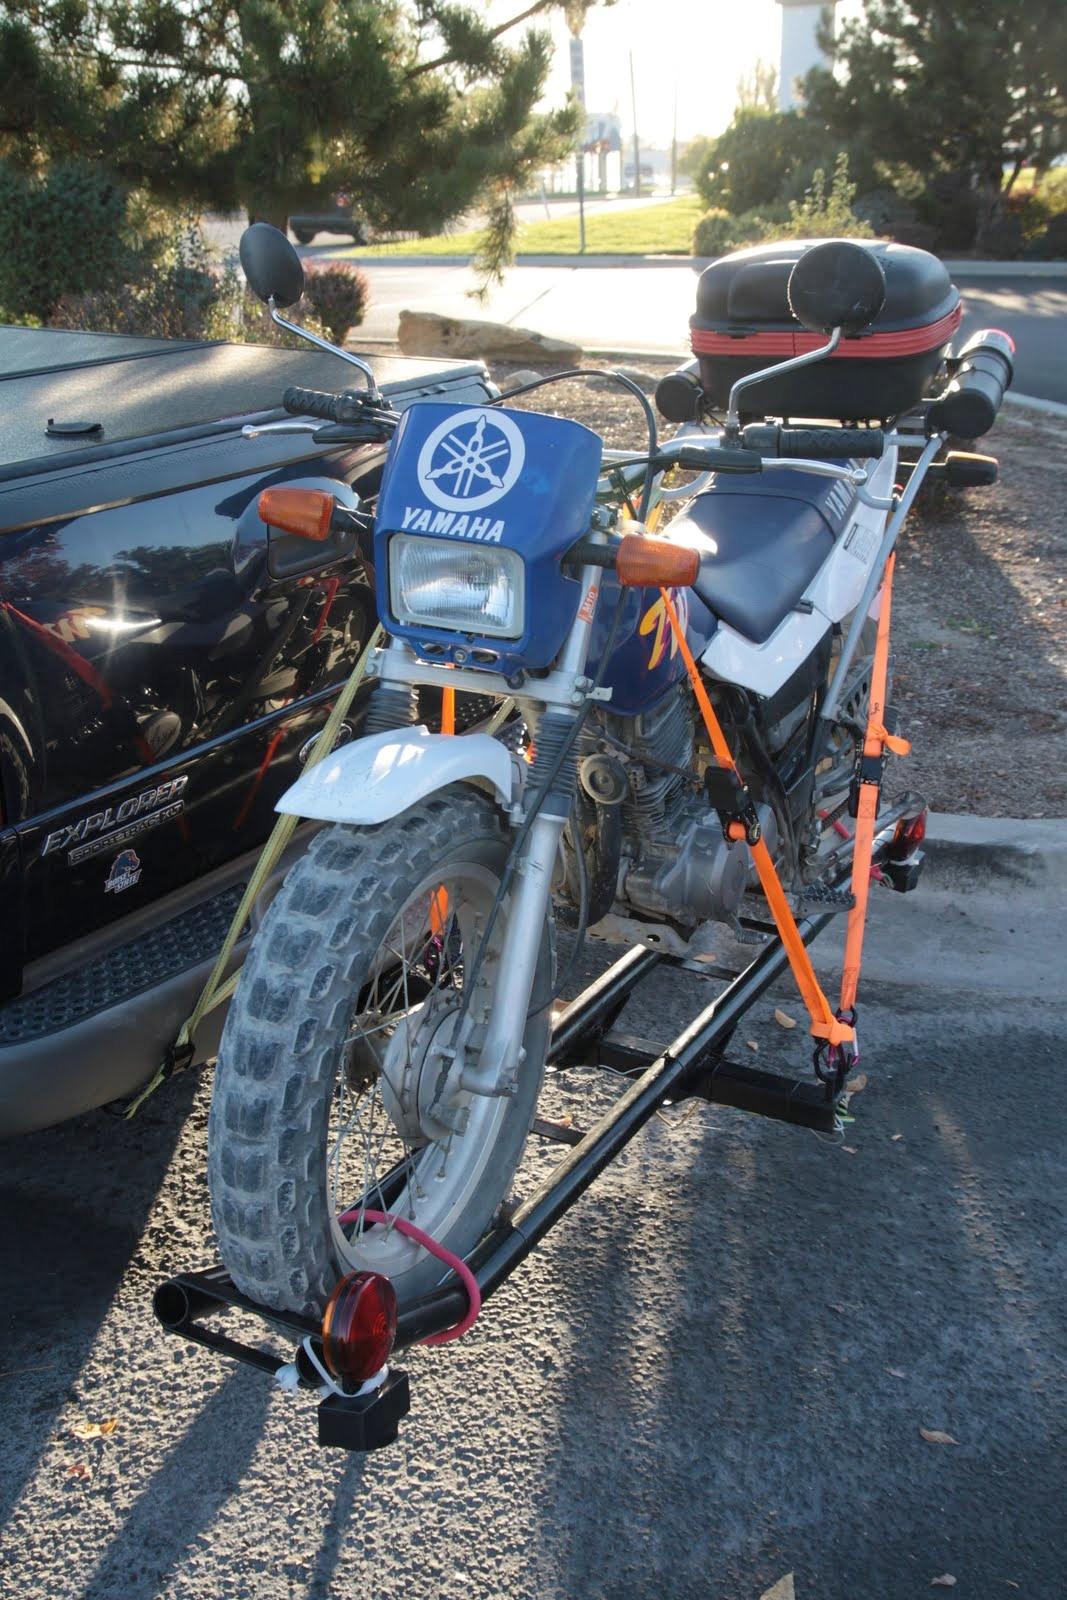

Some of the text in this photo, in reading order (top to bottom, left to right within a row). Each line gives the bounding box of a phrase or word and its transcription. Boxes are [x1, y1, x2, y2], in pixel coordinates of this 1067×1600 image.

[401, 506, 505, 542] YAMAHA
[41, 774, 188, 856] EXPLORER
[162, 803, 182, 820] XLT
[116, 874, 137, 890] STATE
